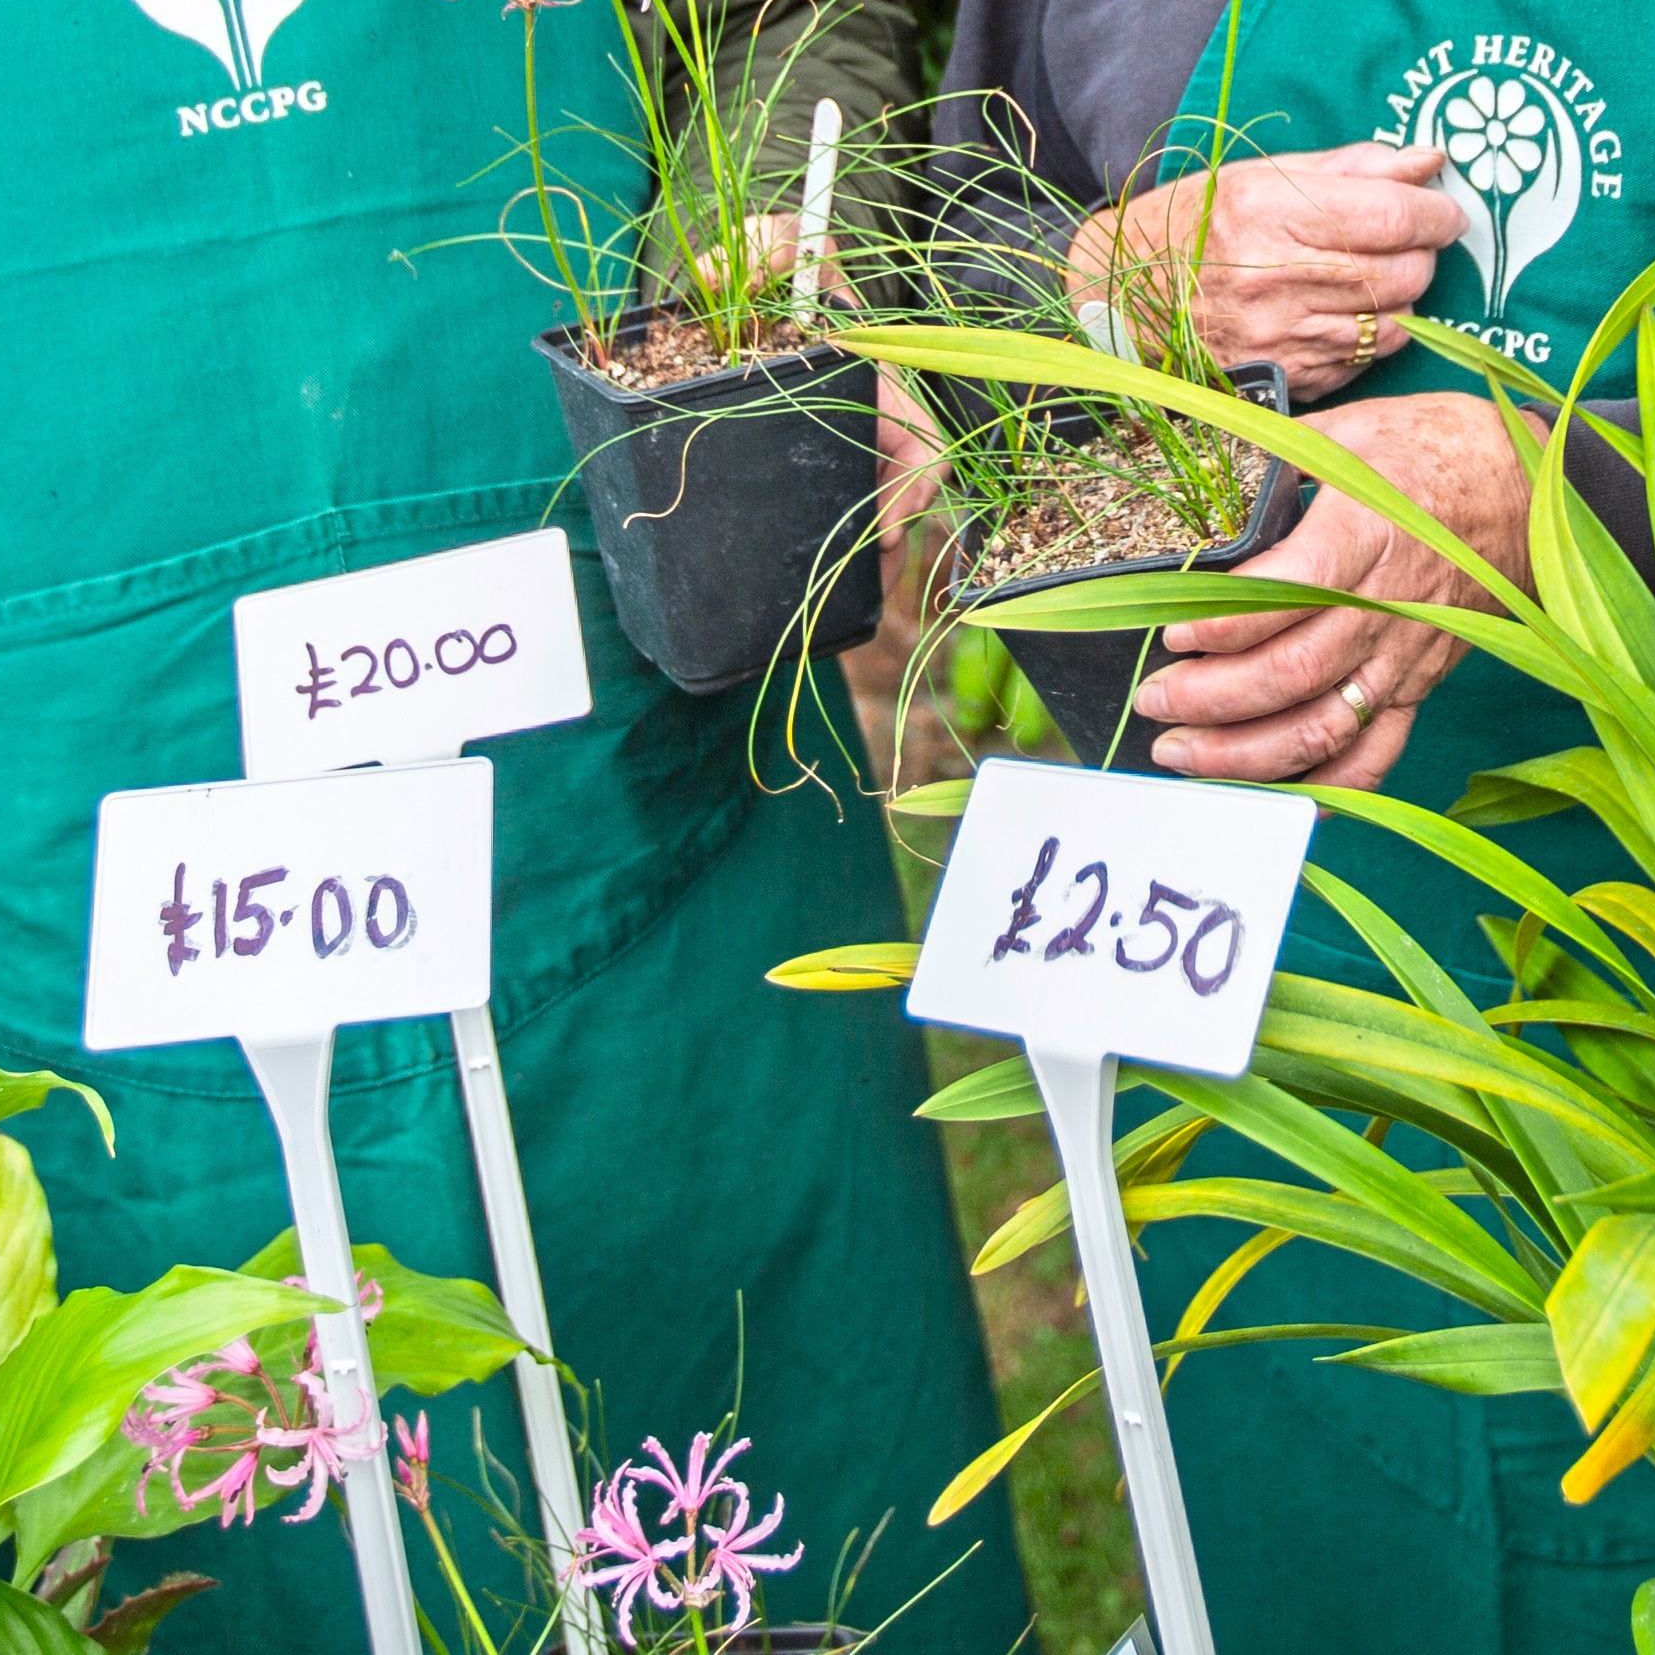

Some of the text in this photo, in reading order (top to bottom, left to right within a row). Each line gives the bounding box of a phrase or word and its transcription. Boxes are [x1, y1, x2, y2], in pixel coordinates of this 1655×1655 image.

[176, 80, 328, 137] NCCPG
[1373, 34, 1623, 201] LANT HERITAGE
[295, 623, 518, 720] £20.00
[159, 862, 415, 977] £15.00
[988, 835, 1245, 997] £2.50
